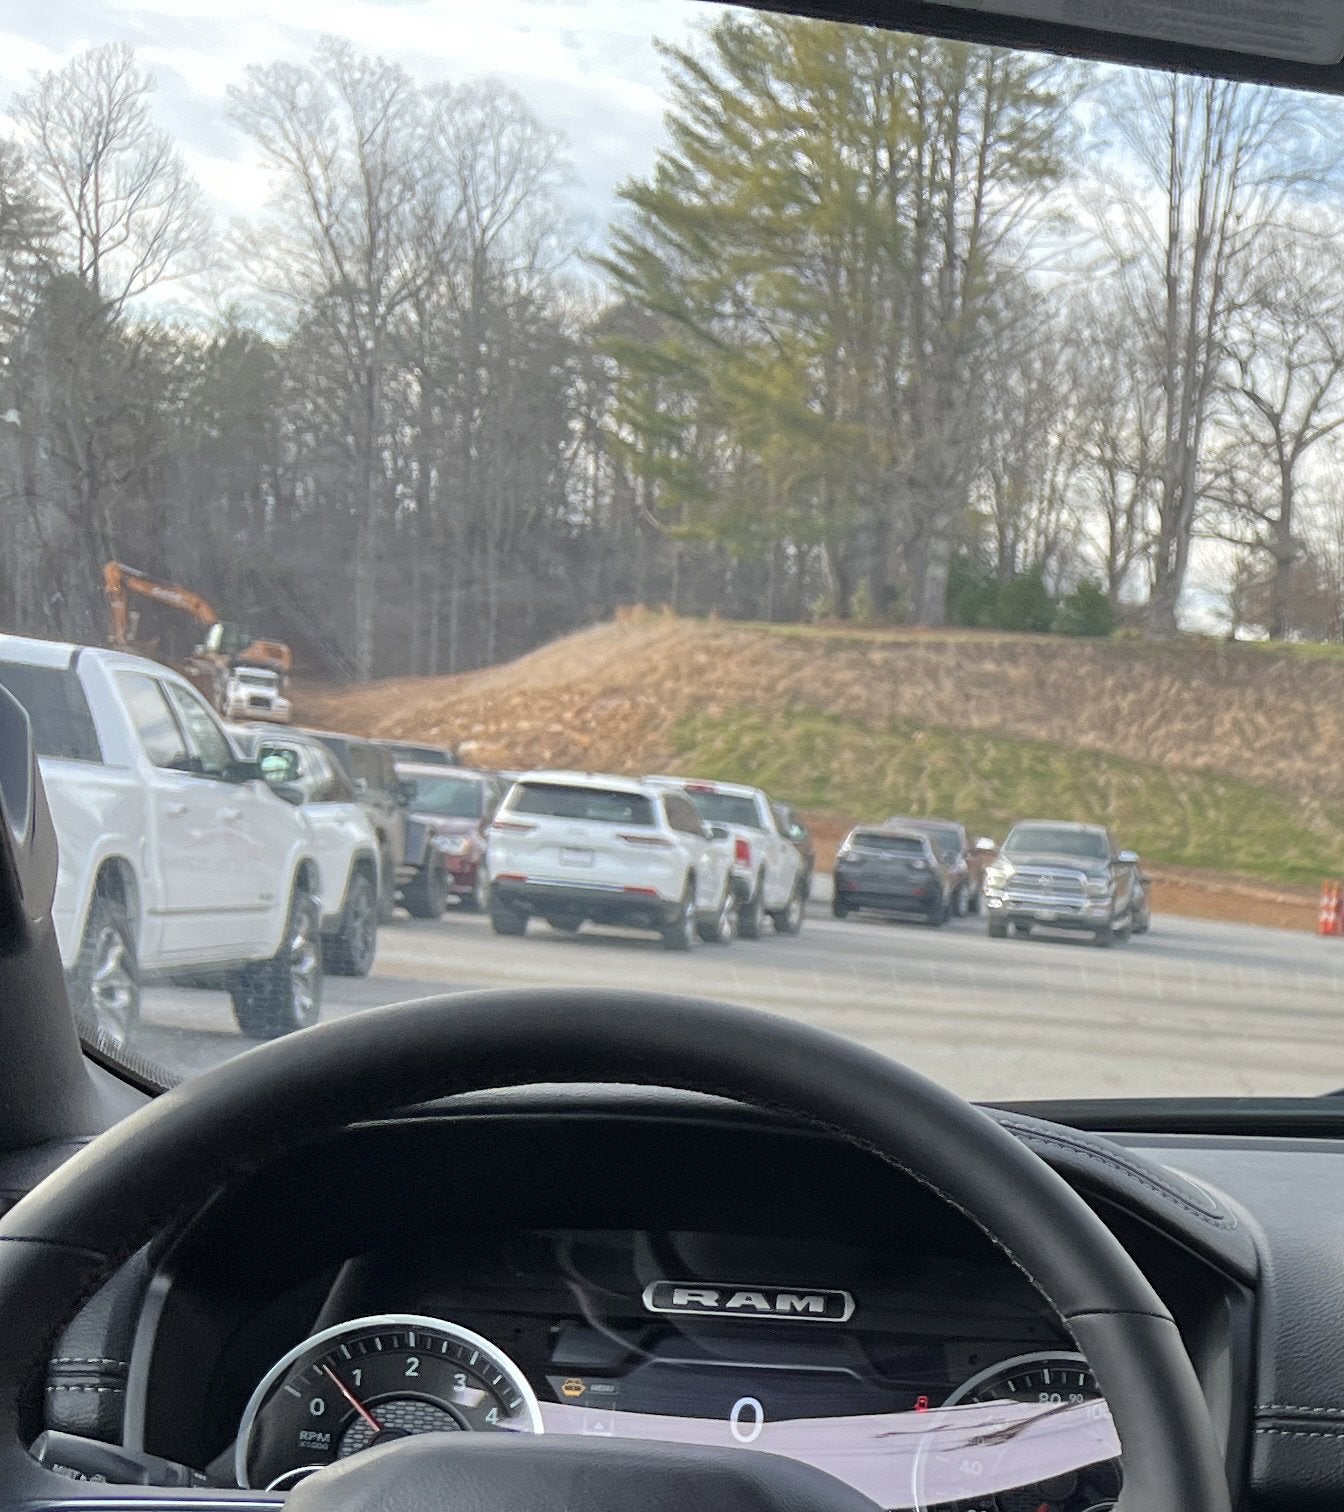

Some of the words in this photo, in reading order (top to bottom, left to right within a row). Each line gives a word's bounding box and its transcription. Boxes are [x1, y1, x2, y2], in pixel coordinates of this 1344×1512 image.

[671, 1287, 826, 1314] RAM
[404, 1357, 421, 1377] 2
[351, 1369, 362, 1387] 1
[453, 1373, 468, 1392] 3
[308, 1398, 325, 1416] 0
[485, 1407, 500, 1424] 4
[729, 1397, 765, 1444] 0
[299, 1430, 331, 1443] RPM
